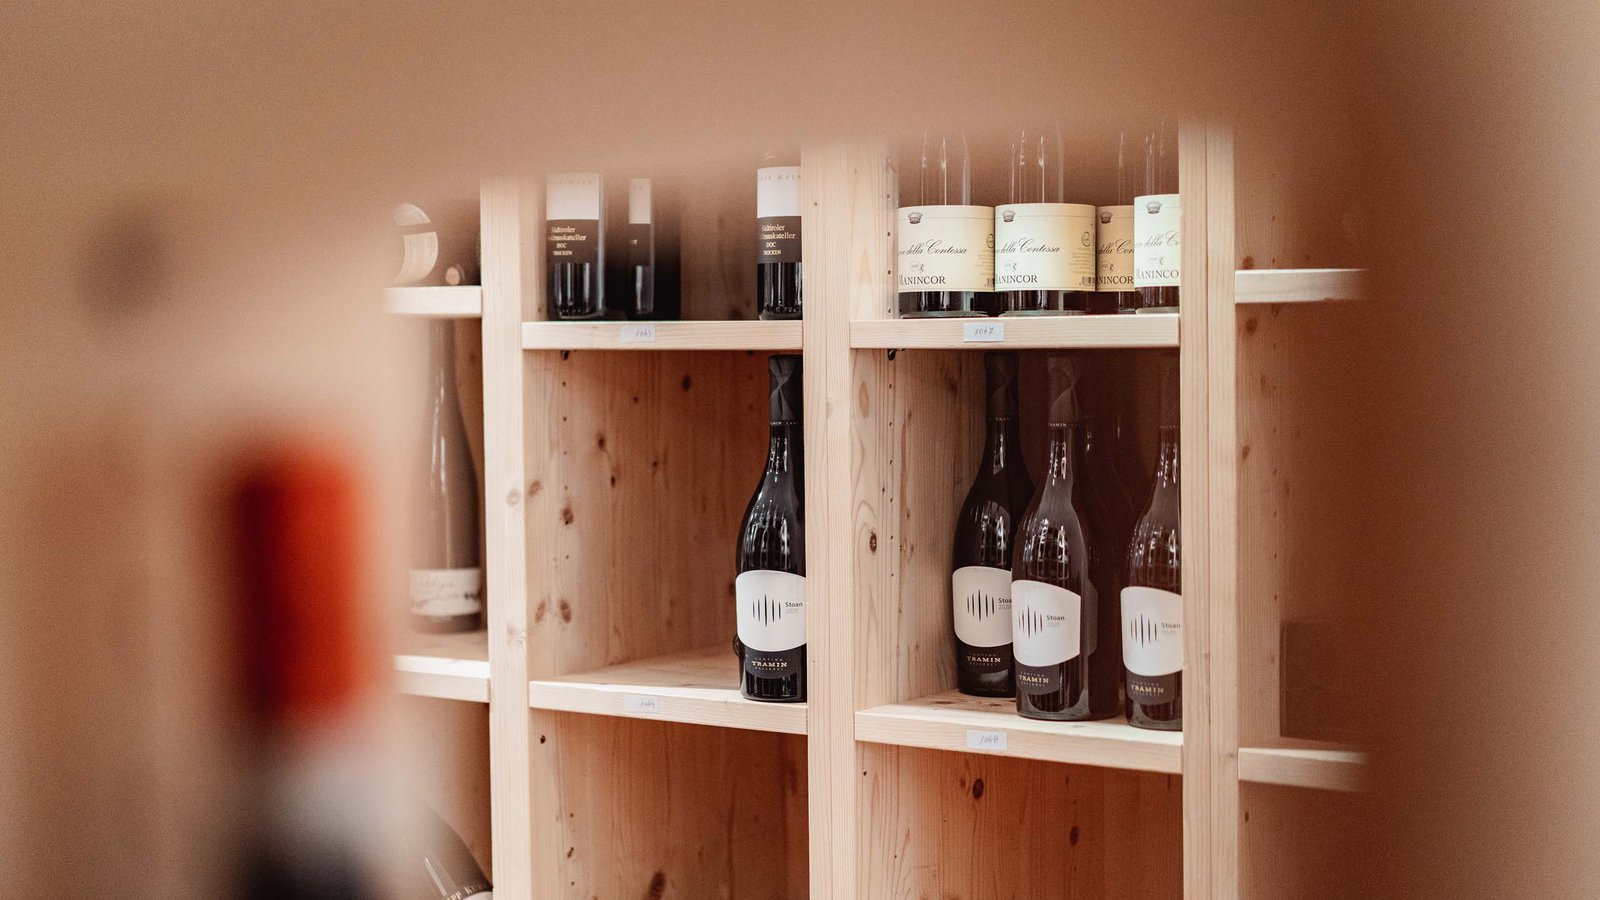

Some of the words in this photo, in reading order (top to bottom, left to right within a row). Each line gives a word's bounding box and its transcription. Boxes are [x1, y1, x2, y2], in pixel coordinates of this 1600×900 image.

[926, 239, 968, 255] Contessa
[1018, 237, 1060, 254] Contessa
[966, 655, 1001, 663] TRAMIN
[1018, 674, 1049, 684] TRAMIN
[1130, 684, 1164, 694] TRAMIN
